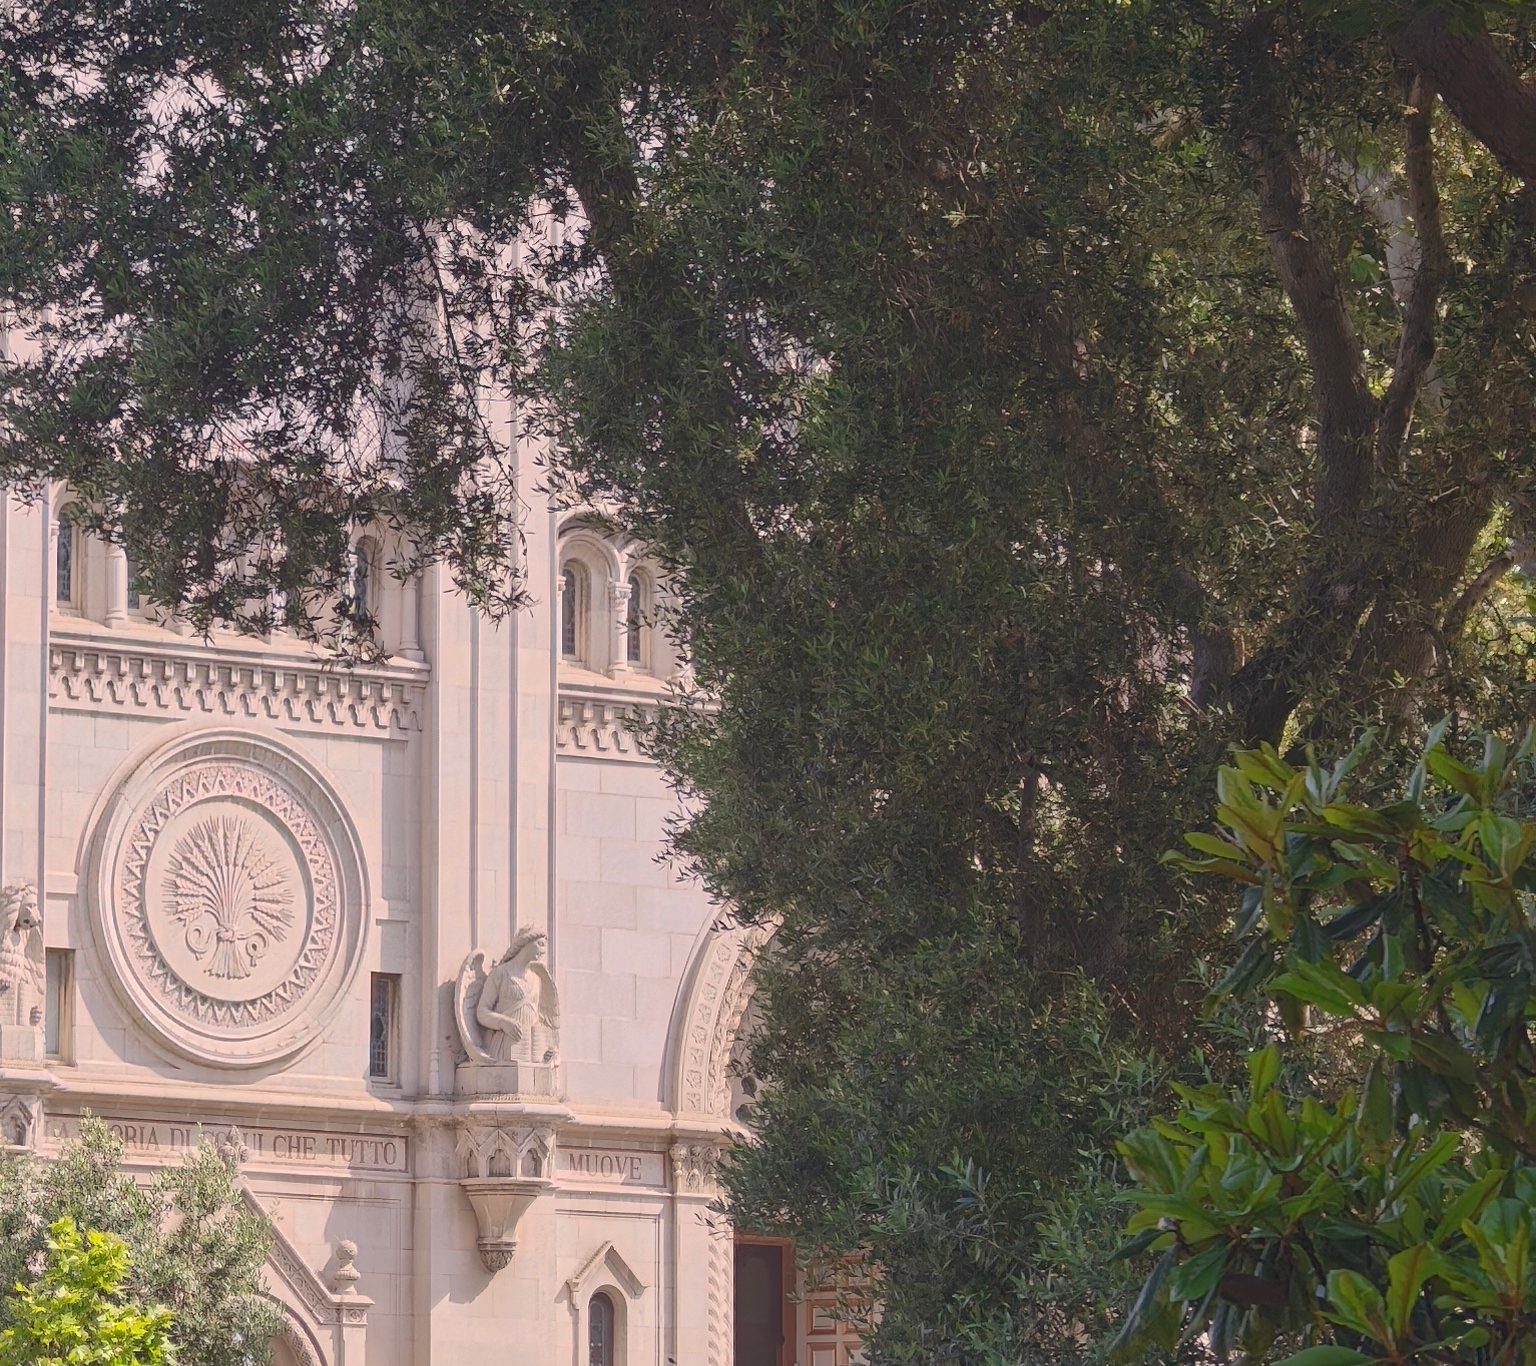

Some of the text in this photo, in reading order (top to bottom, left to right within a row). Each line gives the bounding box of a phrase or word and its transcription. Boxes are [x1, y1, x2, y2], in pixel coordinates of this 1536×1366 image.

[272, 1134, 316, 1161] CHE
[326, 1137, 398, 1166] TUTTO
[568, 1153, 643, 1181] MUOVE
